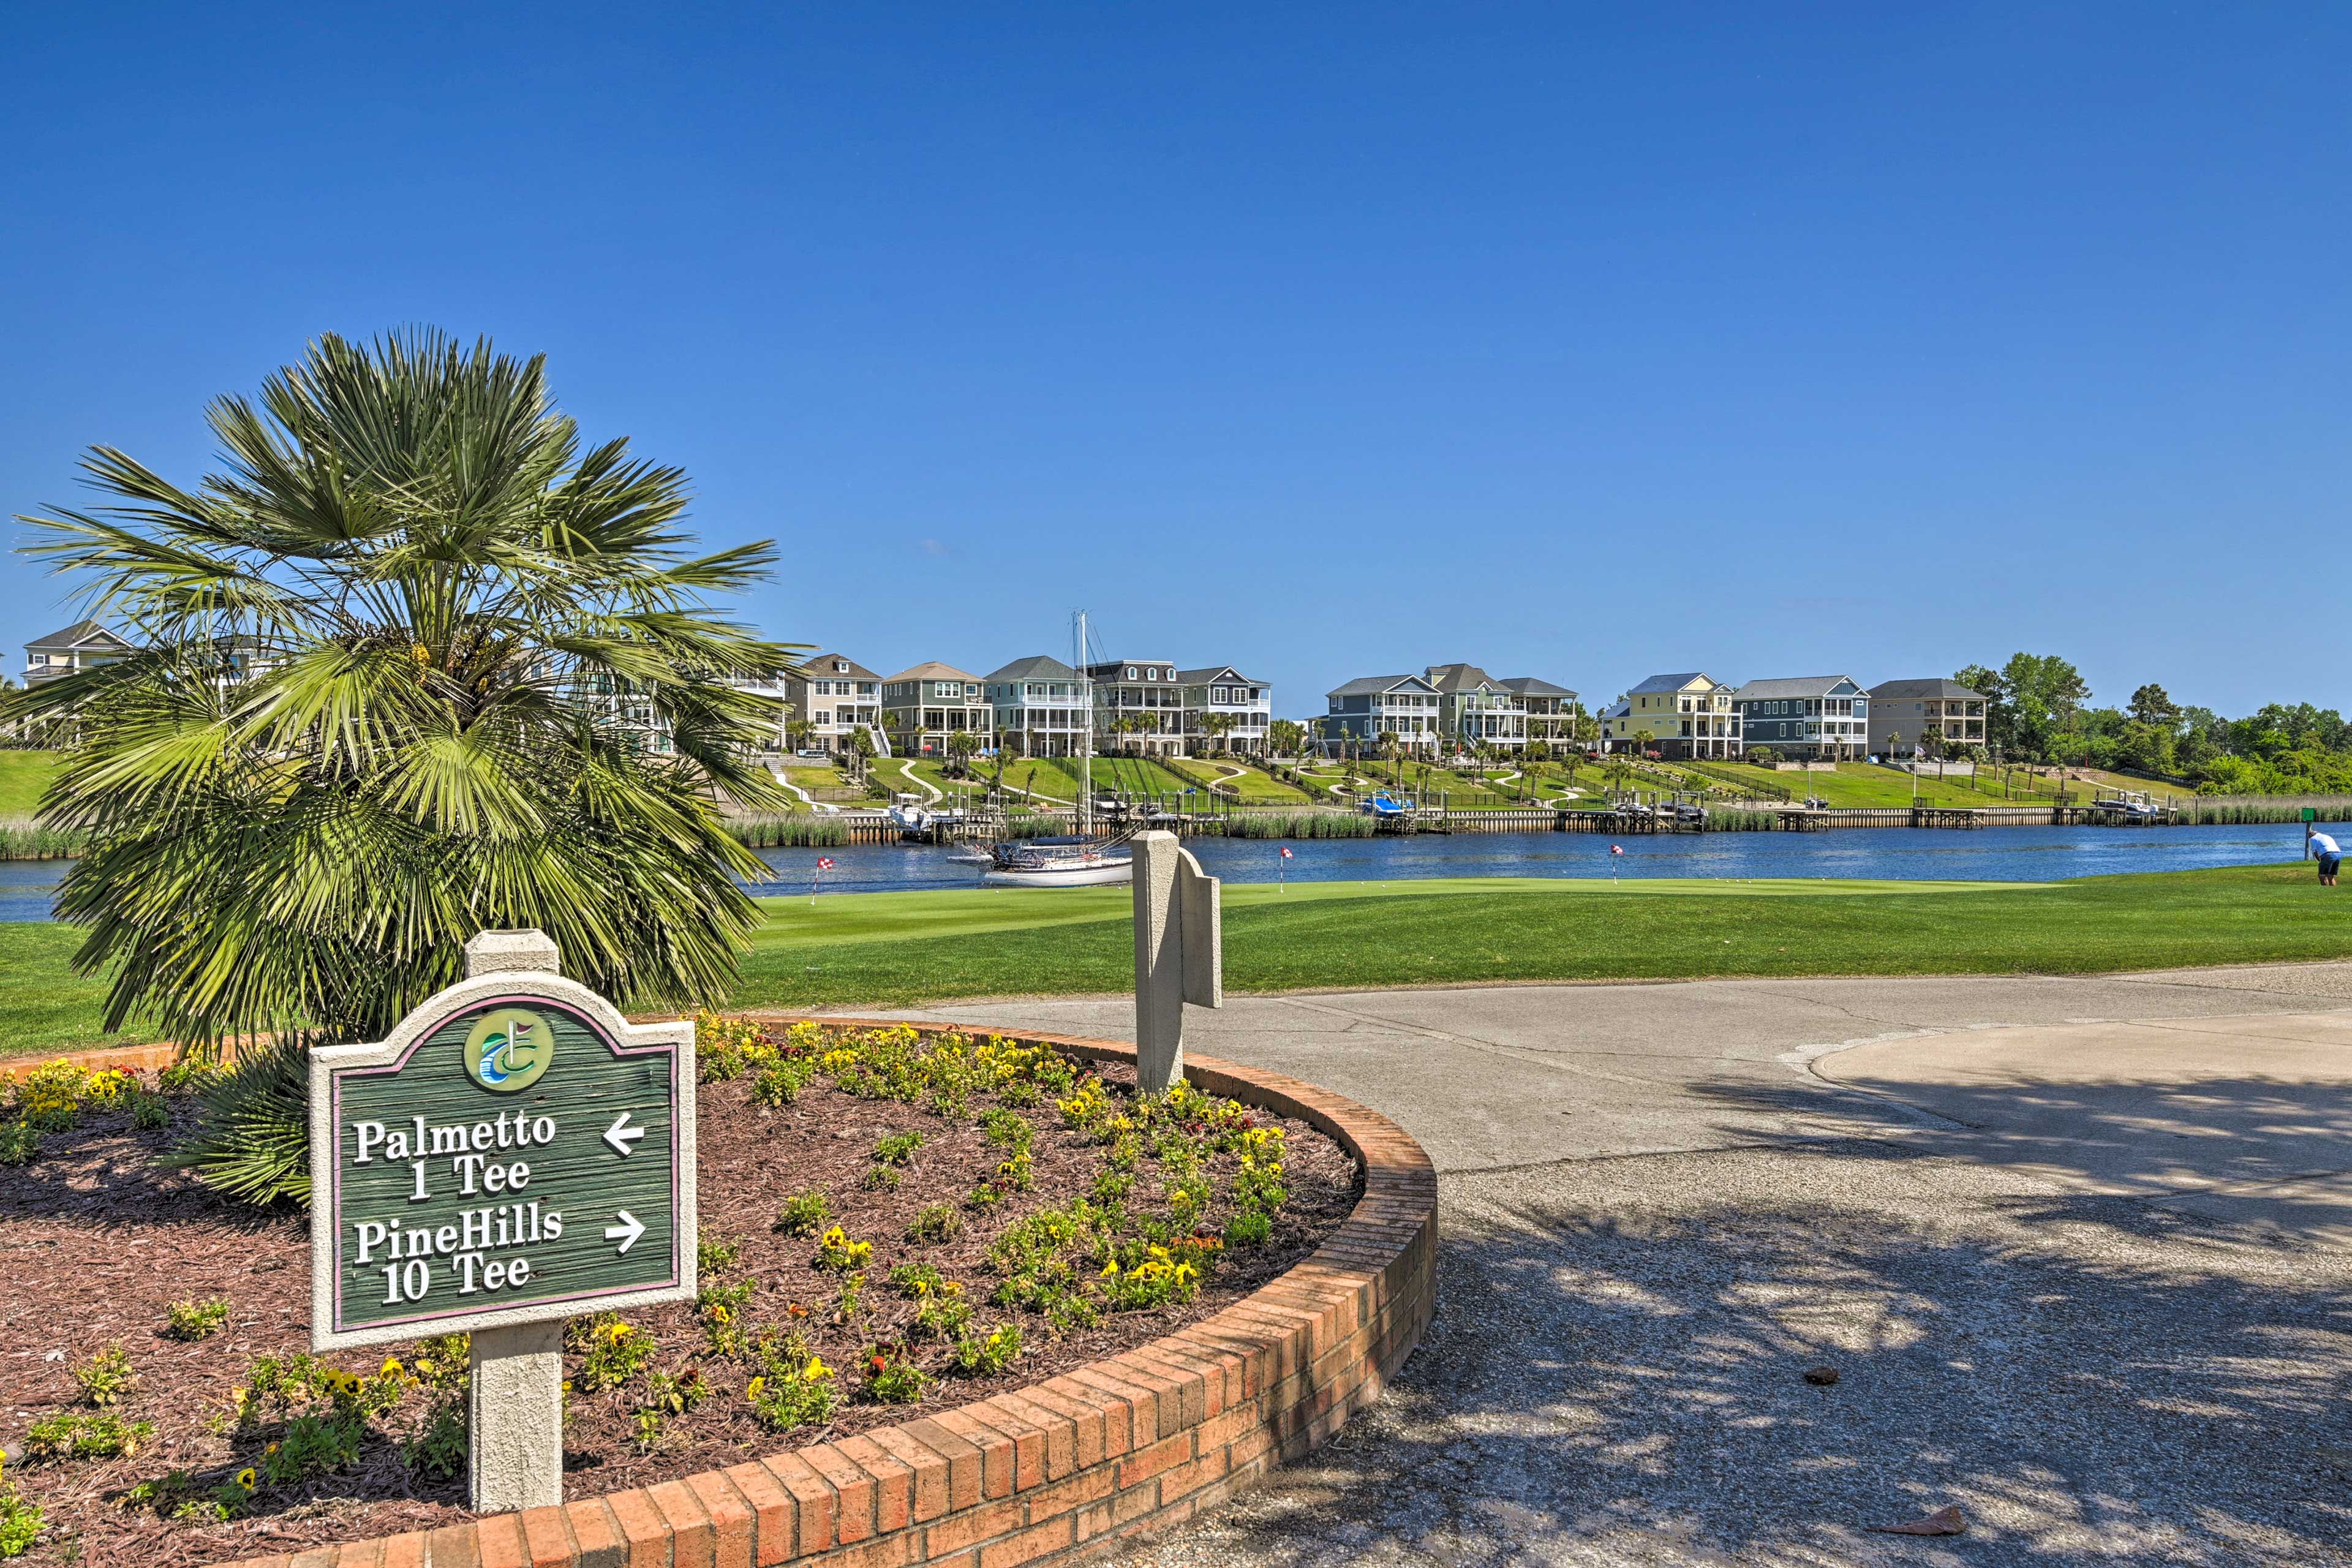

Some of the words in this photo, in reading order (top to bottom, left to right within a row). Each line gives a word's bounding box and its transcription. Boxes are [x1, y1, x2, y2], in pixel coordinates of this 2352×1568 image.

[353, 1110, 556, 1163] Palmetto
[410, 1161, 431, 1200] 1
[454, 1155, 530, 1194] Tee
[353, 1202, 562, 1264] PineHills
[382, 1261, 429, 1305] 10
[453, 1253, 530, 1294] Tee
